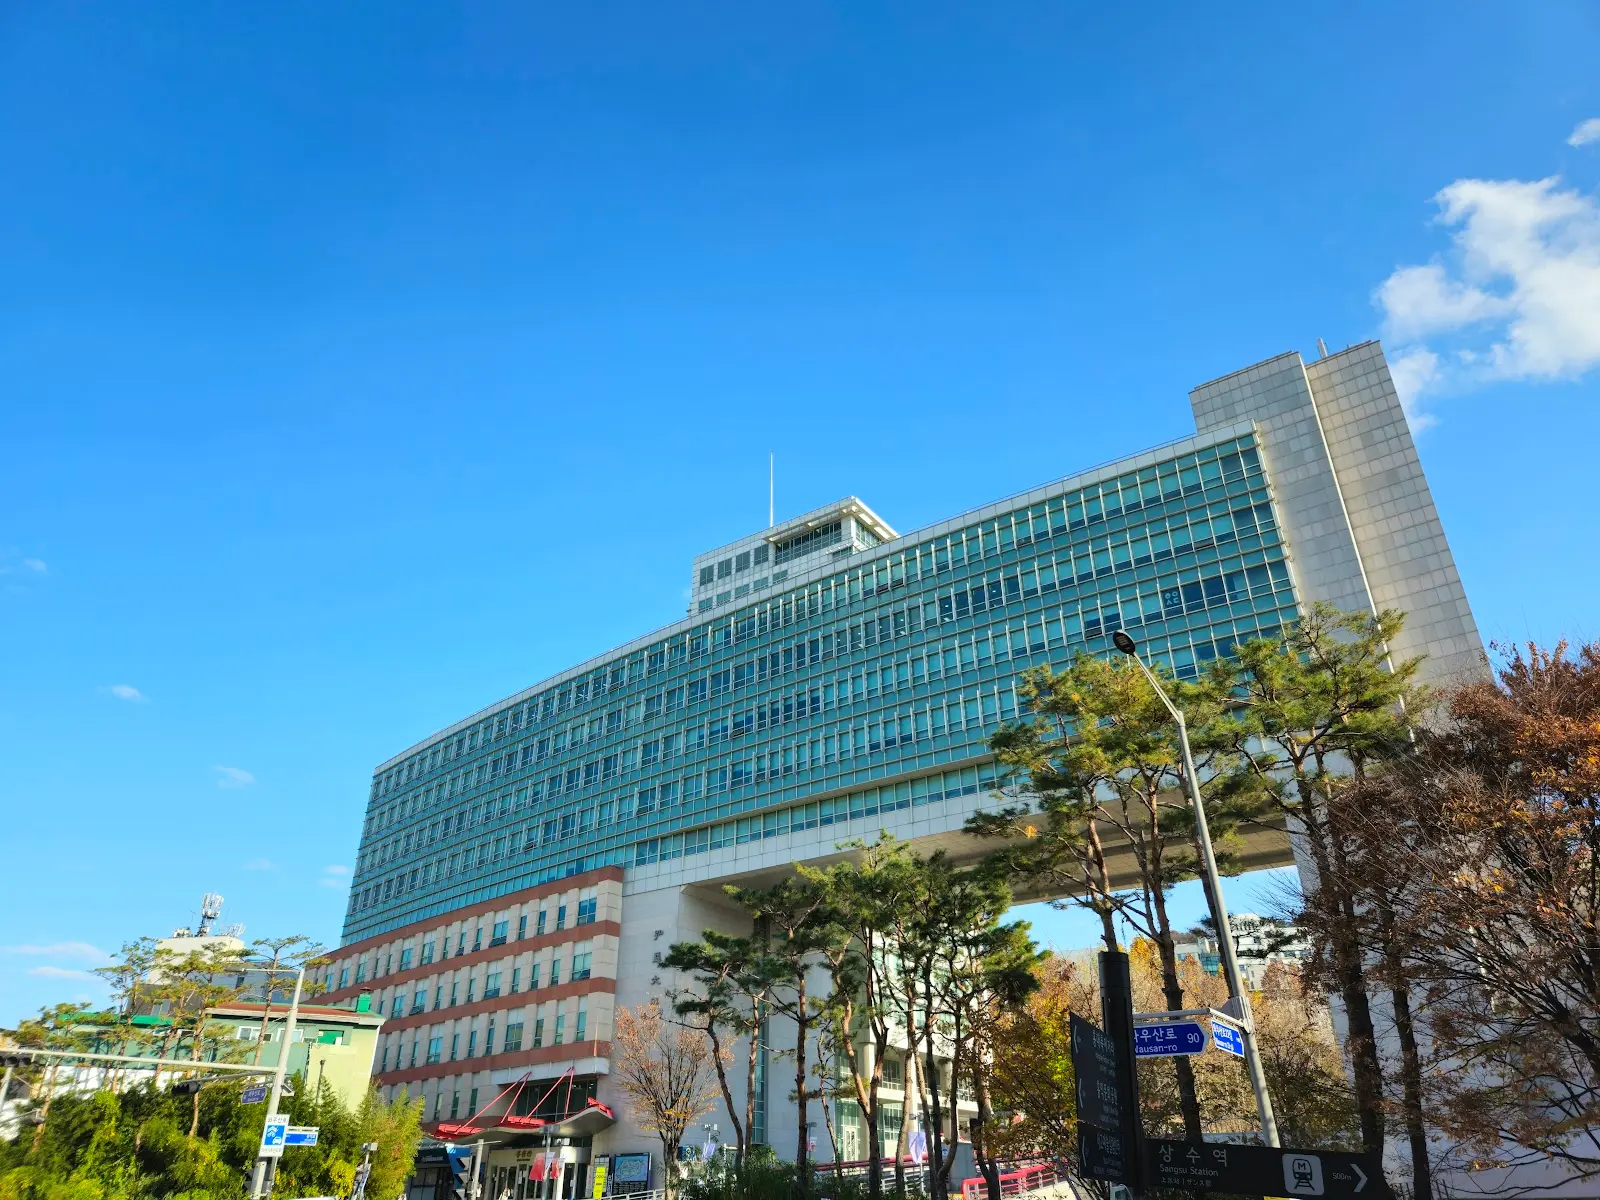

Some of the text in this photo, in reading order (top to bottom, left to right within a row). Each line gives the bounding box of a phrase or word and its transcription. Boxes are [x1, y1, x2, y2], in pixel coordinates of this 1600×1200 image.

[1187, 1033, 1200, 1043] 90
[1159, 1144, 1228, 1168] 상수역
[1159, 1163, 1219, 1177] Sangsu Station
[1332, 1172, 1352, 1181] 500m
